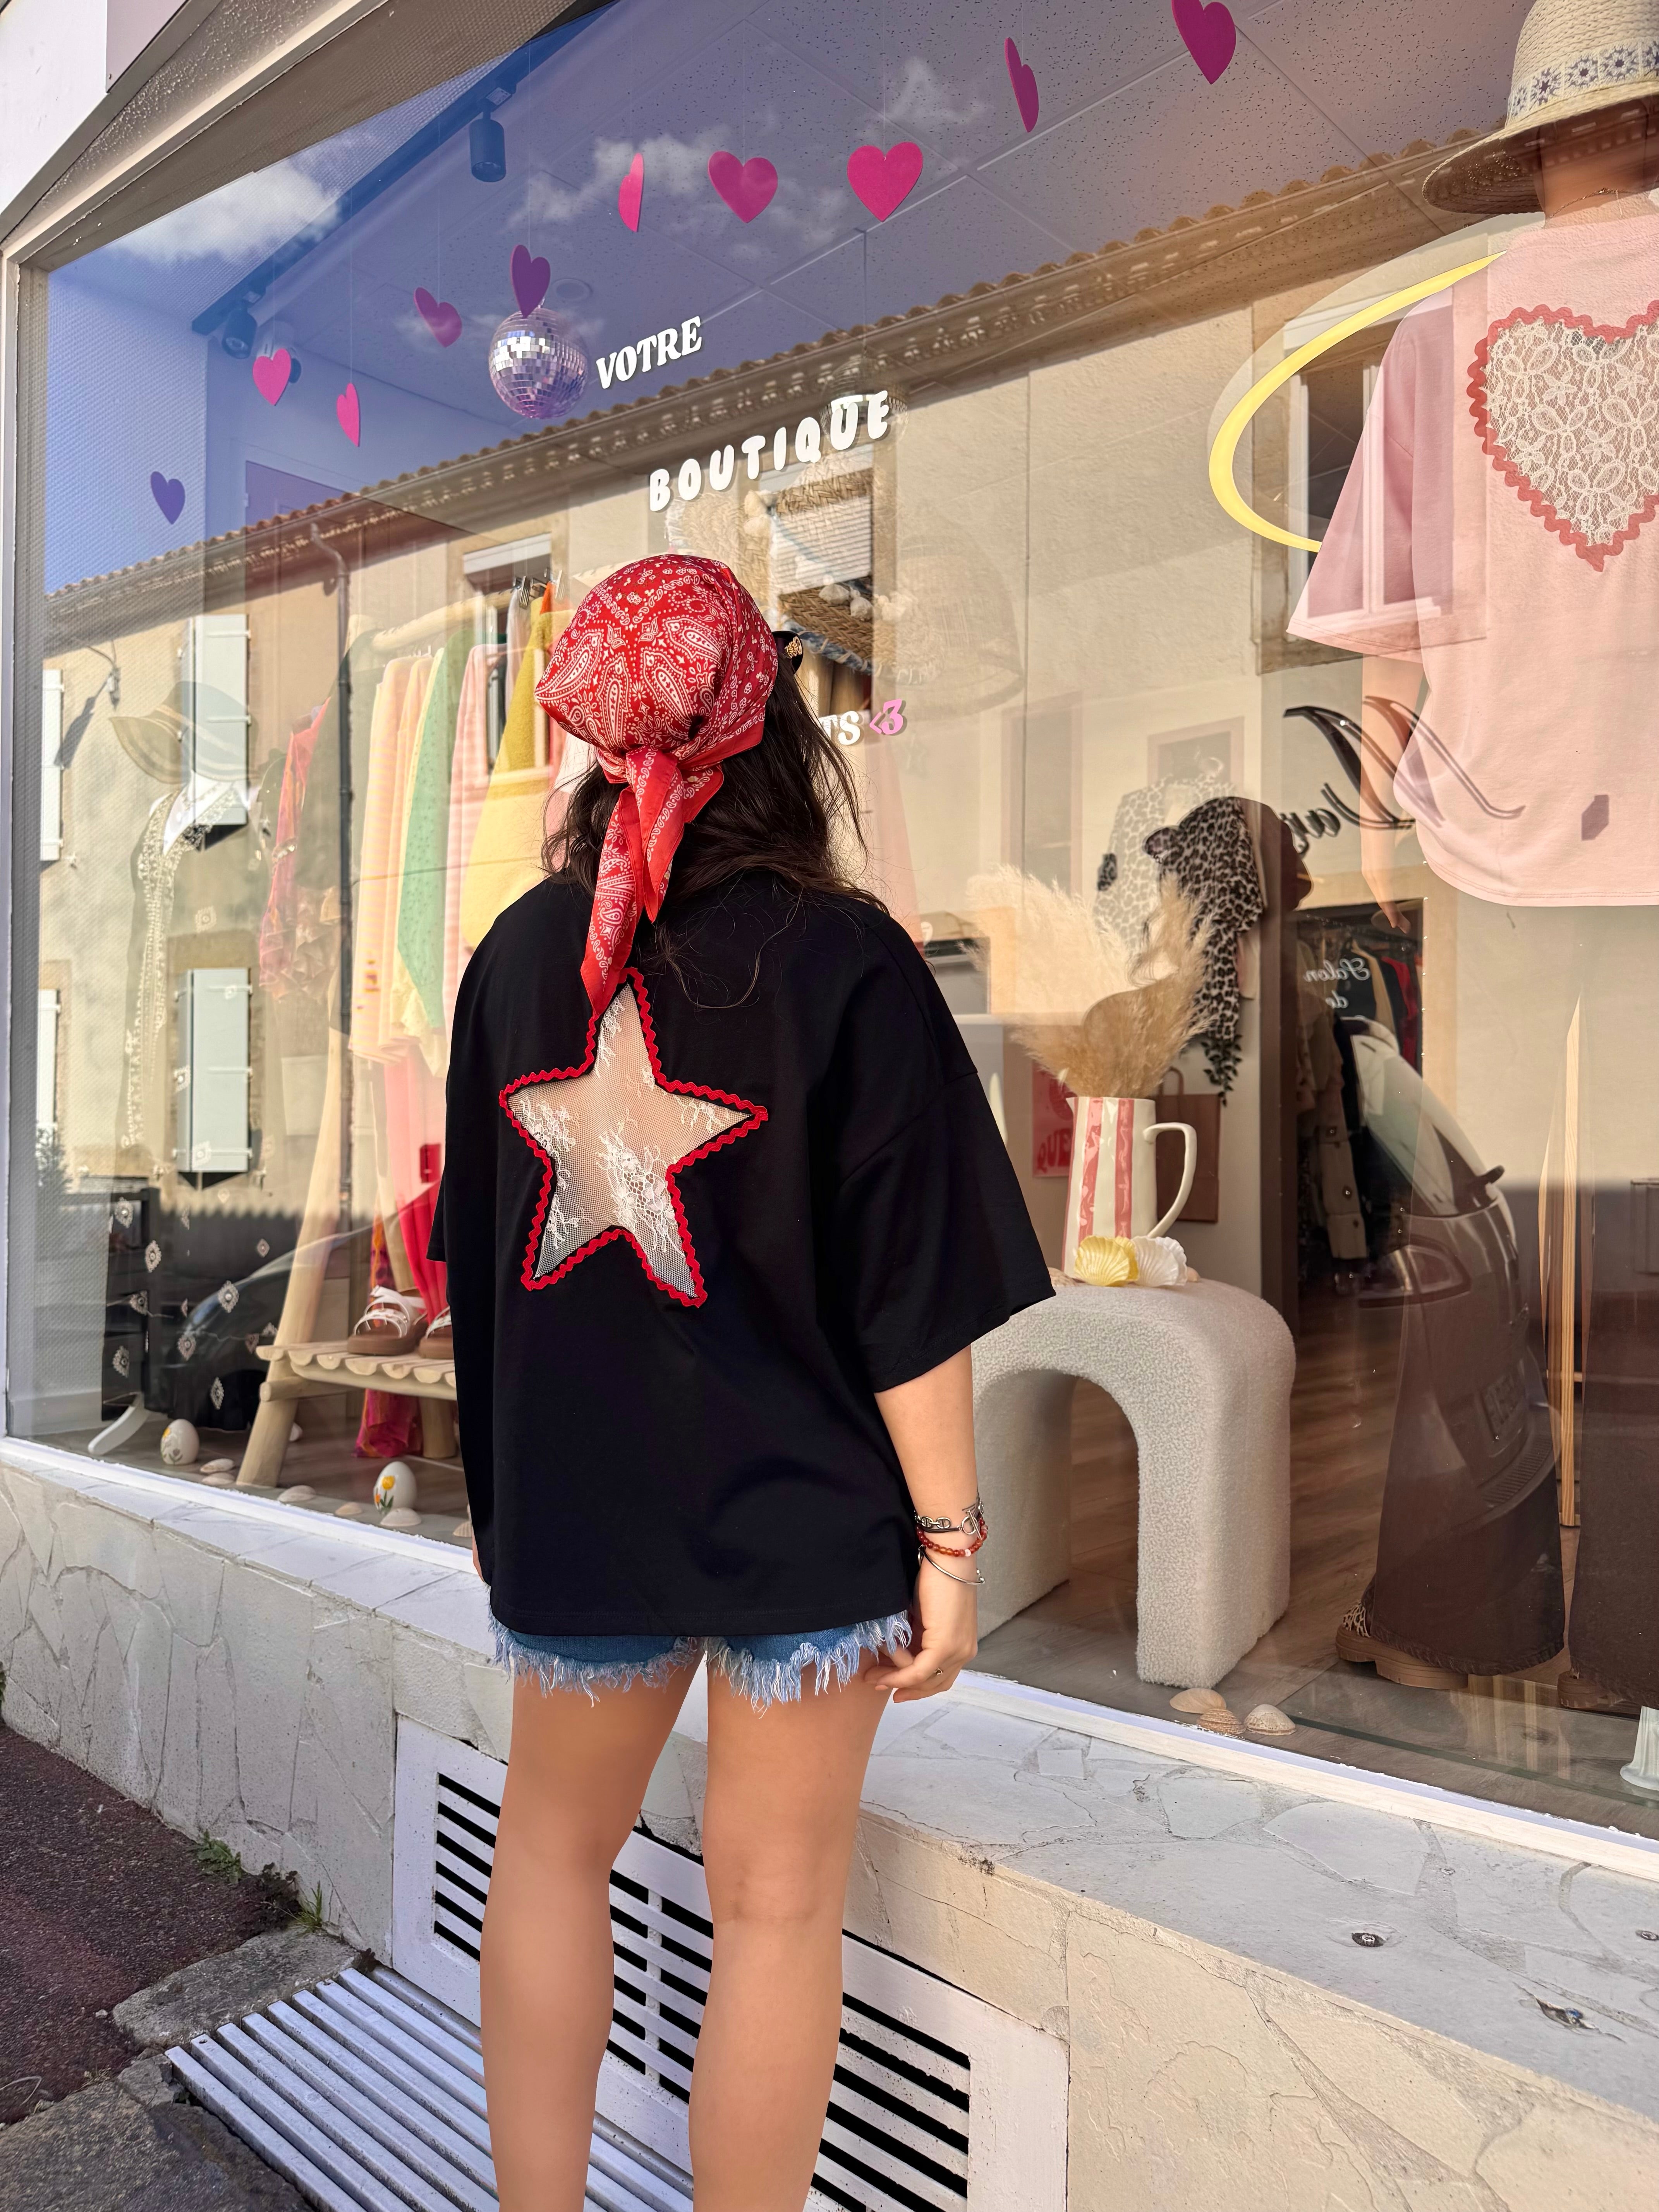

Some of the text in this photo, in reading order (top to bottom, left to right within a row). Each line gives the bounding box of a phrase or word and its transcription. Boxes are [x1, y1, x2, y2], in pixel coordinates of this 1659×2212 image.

[596, 316, 702, 389] VOTRE
[649, 390, 889, 512] BOUTIQUE
[818, 711, 861, 745] TS
